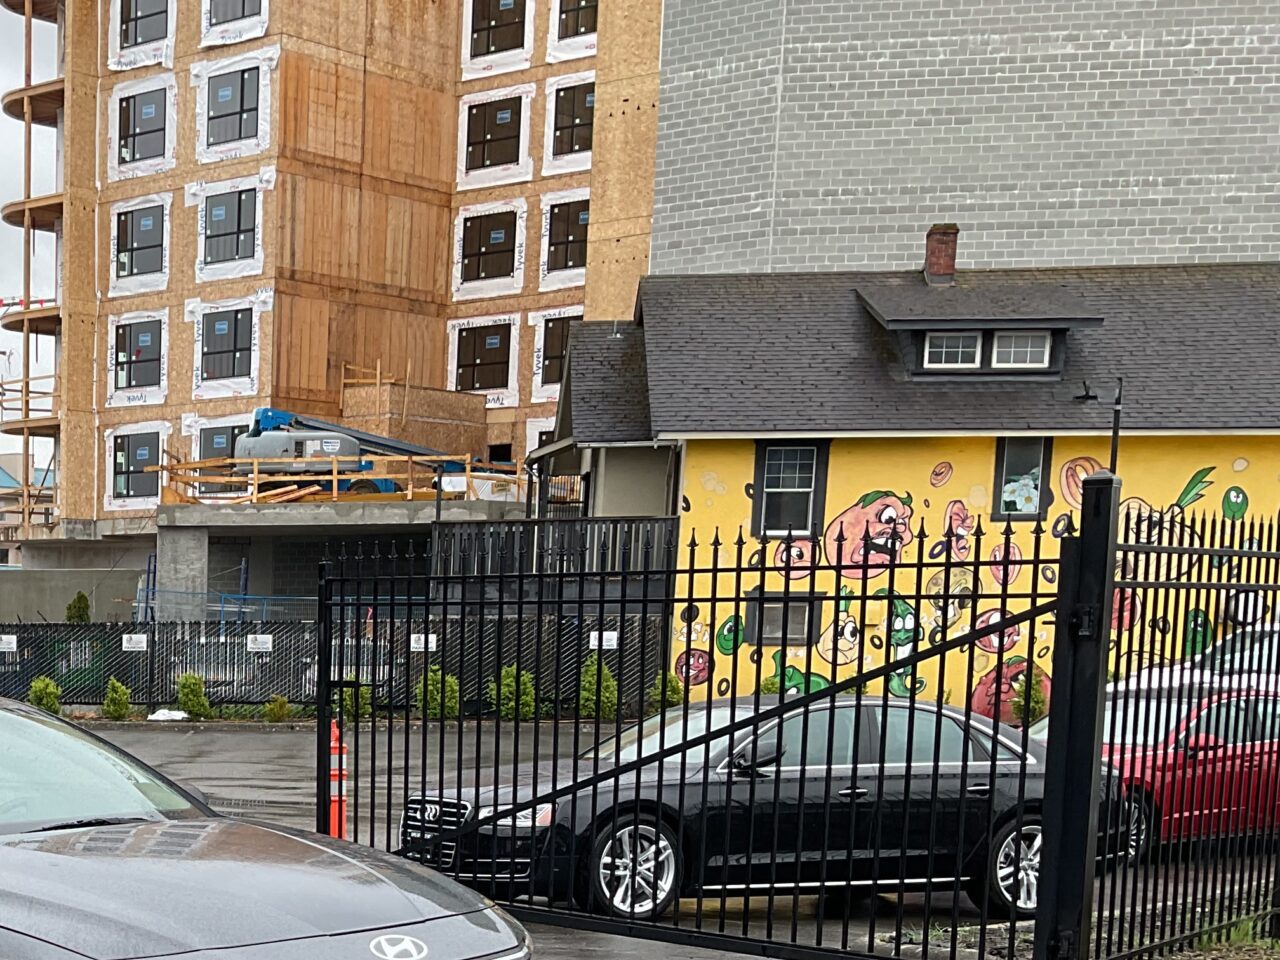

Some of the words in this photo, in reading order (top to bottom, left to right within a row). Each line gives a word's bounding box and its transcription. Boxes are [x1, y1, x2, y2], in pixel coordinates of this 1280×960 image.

[542, 208, 551, 238] Tyvek
[516, 242, 525, 271] Tyvek
[534, 347, 542, 376] Tyvek
[126, 390, 147, 403] Tyvek
